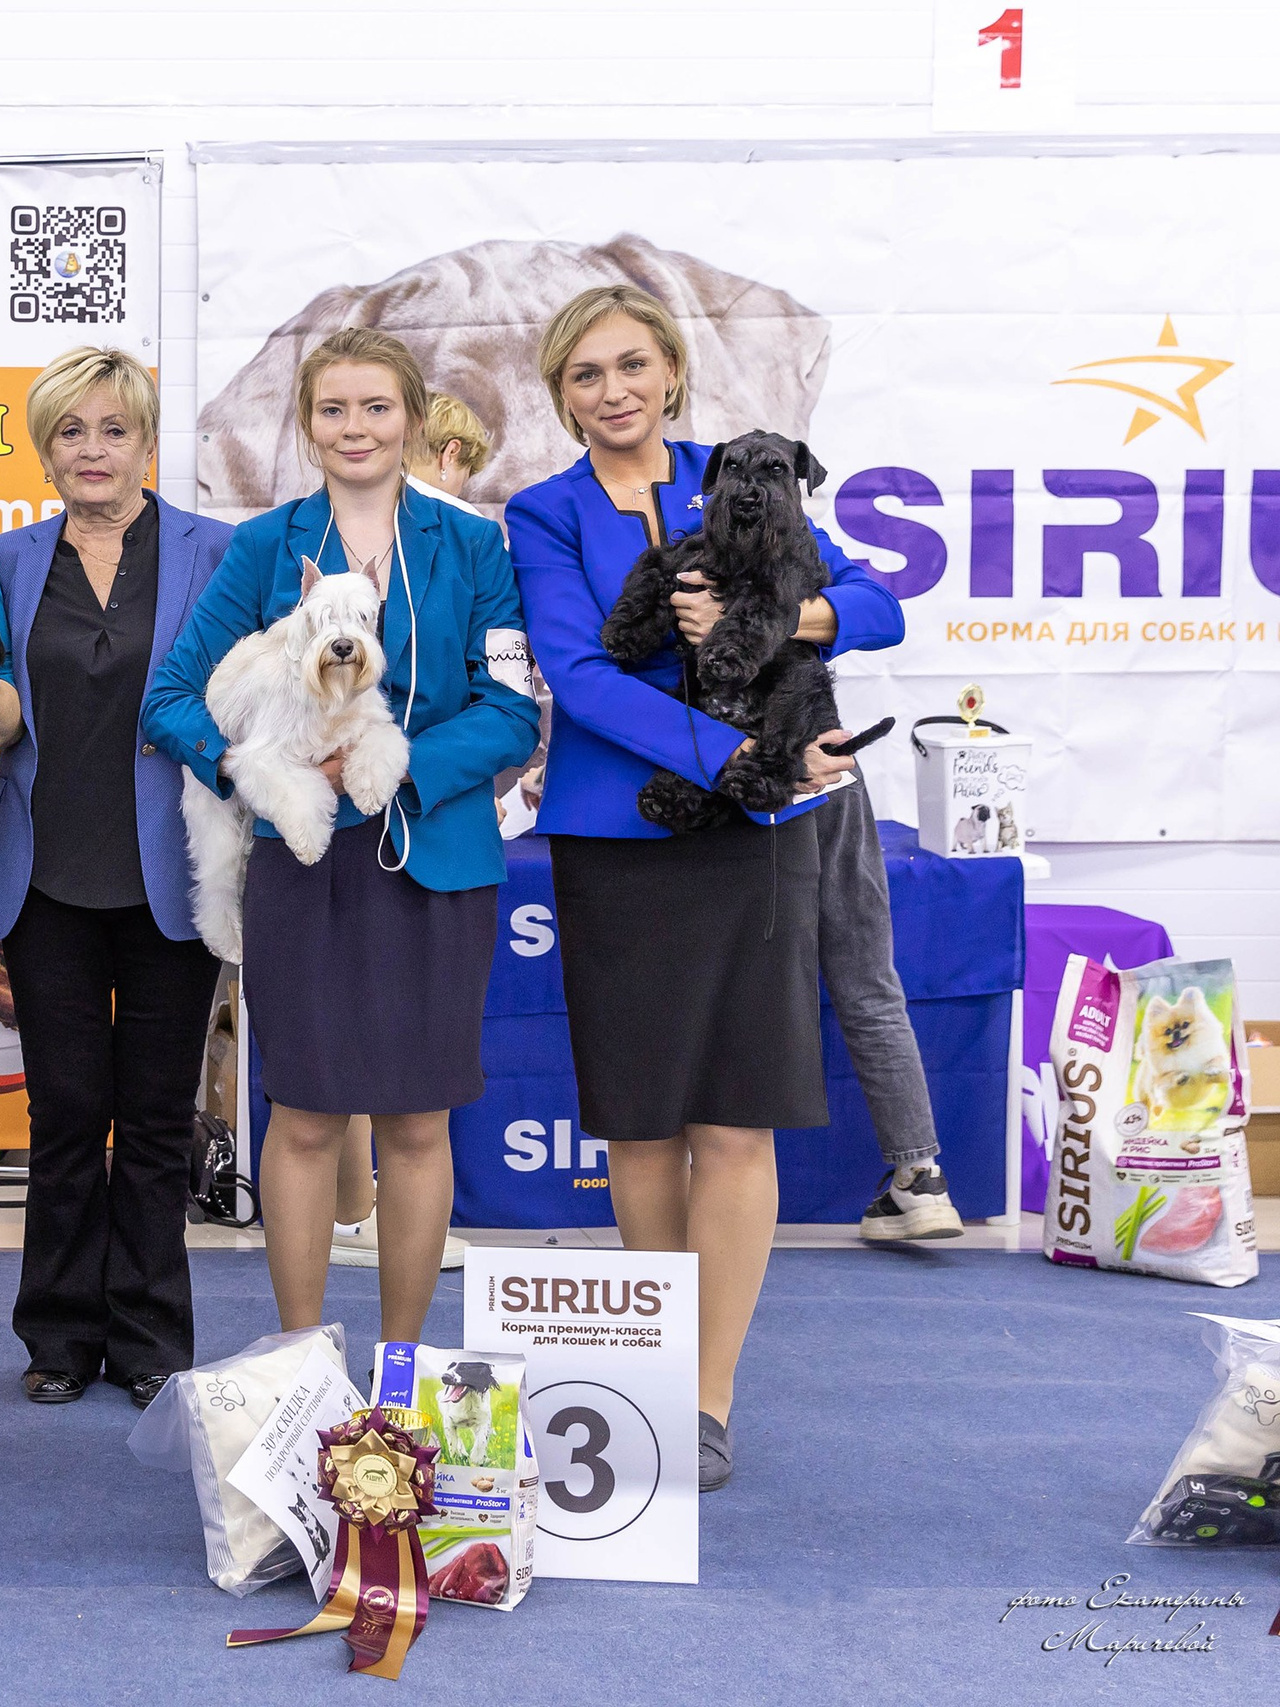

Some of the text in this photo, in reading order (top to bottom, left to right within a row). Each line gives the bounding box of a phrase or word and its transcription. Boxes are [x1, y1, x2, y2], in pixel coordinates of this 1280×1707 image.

[978, 9, 1023, 89] 1
[835, 466, 1280, 600] SIRI
[947, 621, 1055, 642] КОРМА
[1066, 621, 1129, 646] ДЛЯ
[1141, 621, 1236, 642] СОБАК
[1246, 621, 1265, 642] И
[1057, 1060, 1102, 1236] SIRIUS
[573, 1178, 609, 1189] FOOD
[488, 1276, 496, 1312] PREMIUM
[501, 1276, 662, 1316] SIRIUS
[501, 1322, 662, 1337] Корма премиум-класса
[533, 1335, 662, 1348] для кошек и собак
[545, 1406, 616, 1513] 3
[475, 1499, 506, 1507] ProStor+
